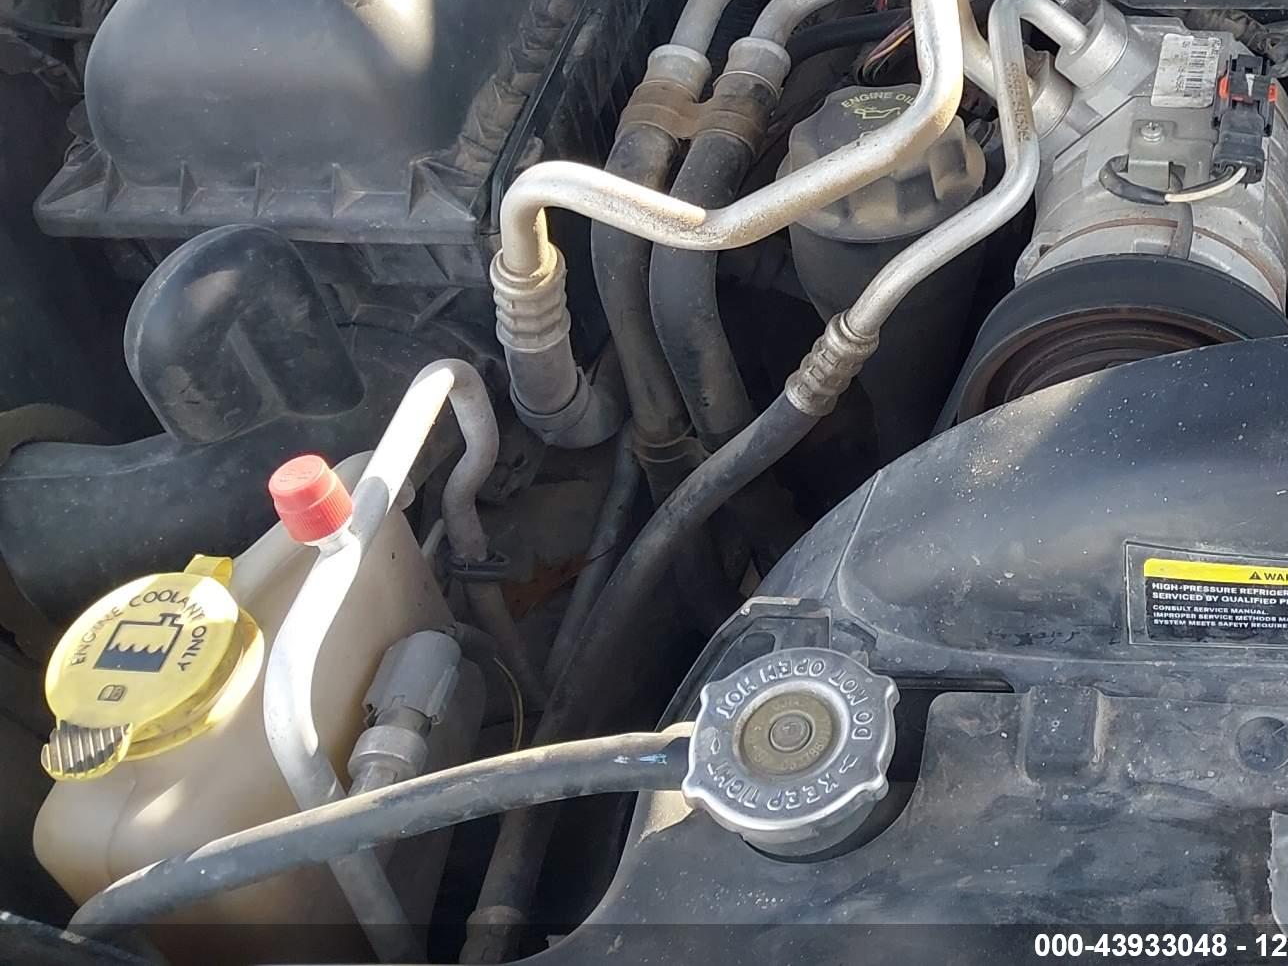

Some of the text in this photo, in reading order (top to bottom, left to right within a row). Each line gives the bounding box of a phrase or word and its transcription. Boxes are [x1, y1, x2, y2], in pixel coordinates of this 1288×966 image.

[841, 91, 917, 109] ENGINE OIL
[1151, 582, 1237, 594] HIGH-PRESSURE
[1152, 592, 1204, 602] SERVICED
[1221, 595, 1277, 605] QUALIFIED
[1152, 604, 1191, 612] CONSULT
[1193, 605, 1229, 613] SERVICE
[1153, 612, 1197, 620] IMPROPER
[1198, 613, 1234, 621] SERVICE
[70, 589, 208, 672] ENGINE COOLANT ONLY
[1218, 620, 1249, 628] SAFETY
[759, 656, 827, 683] OPEN
[715, 675, 760, 720] HOT
[828, 669, 870, 707] NOT
[851, 709, 874, 741] DO
[705, 762, 840, 812] KEEP TIGHT
